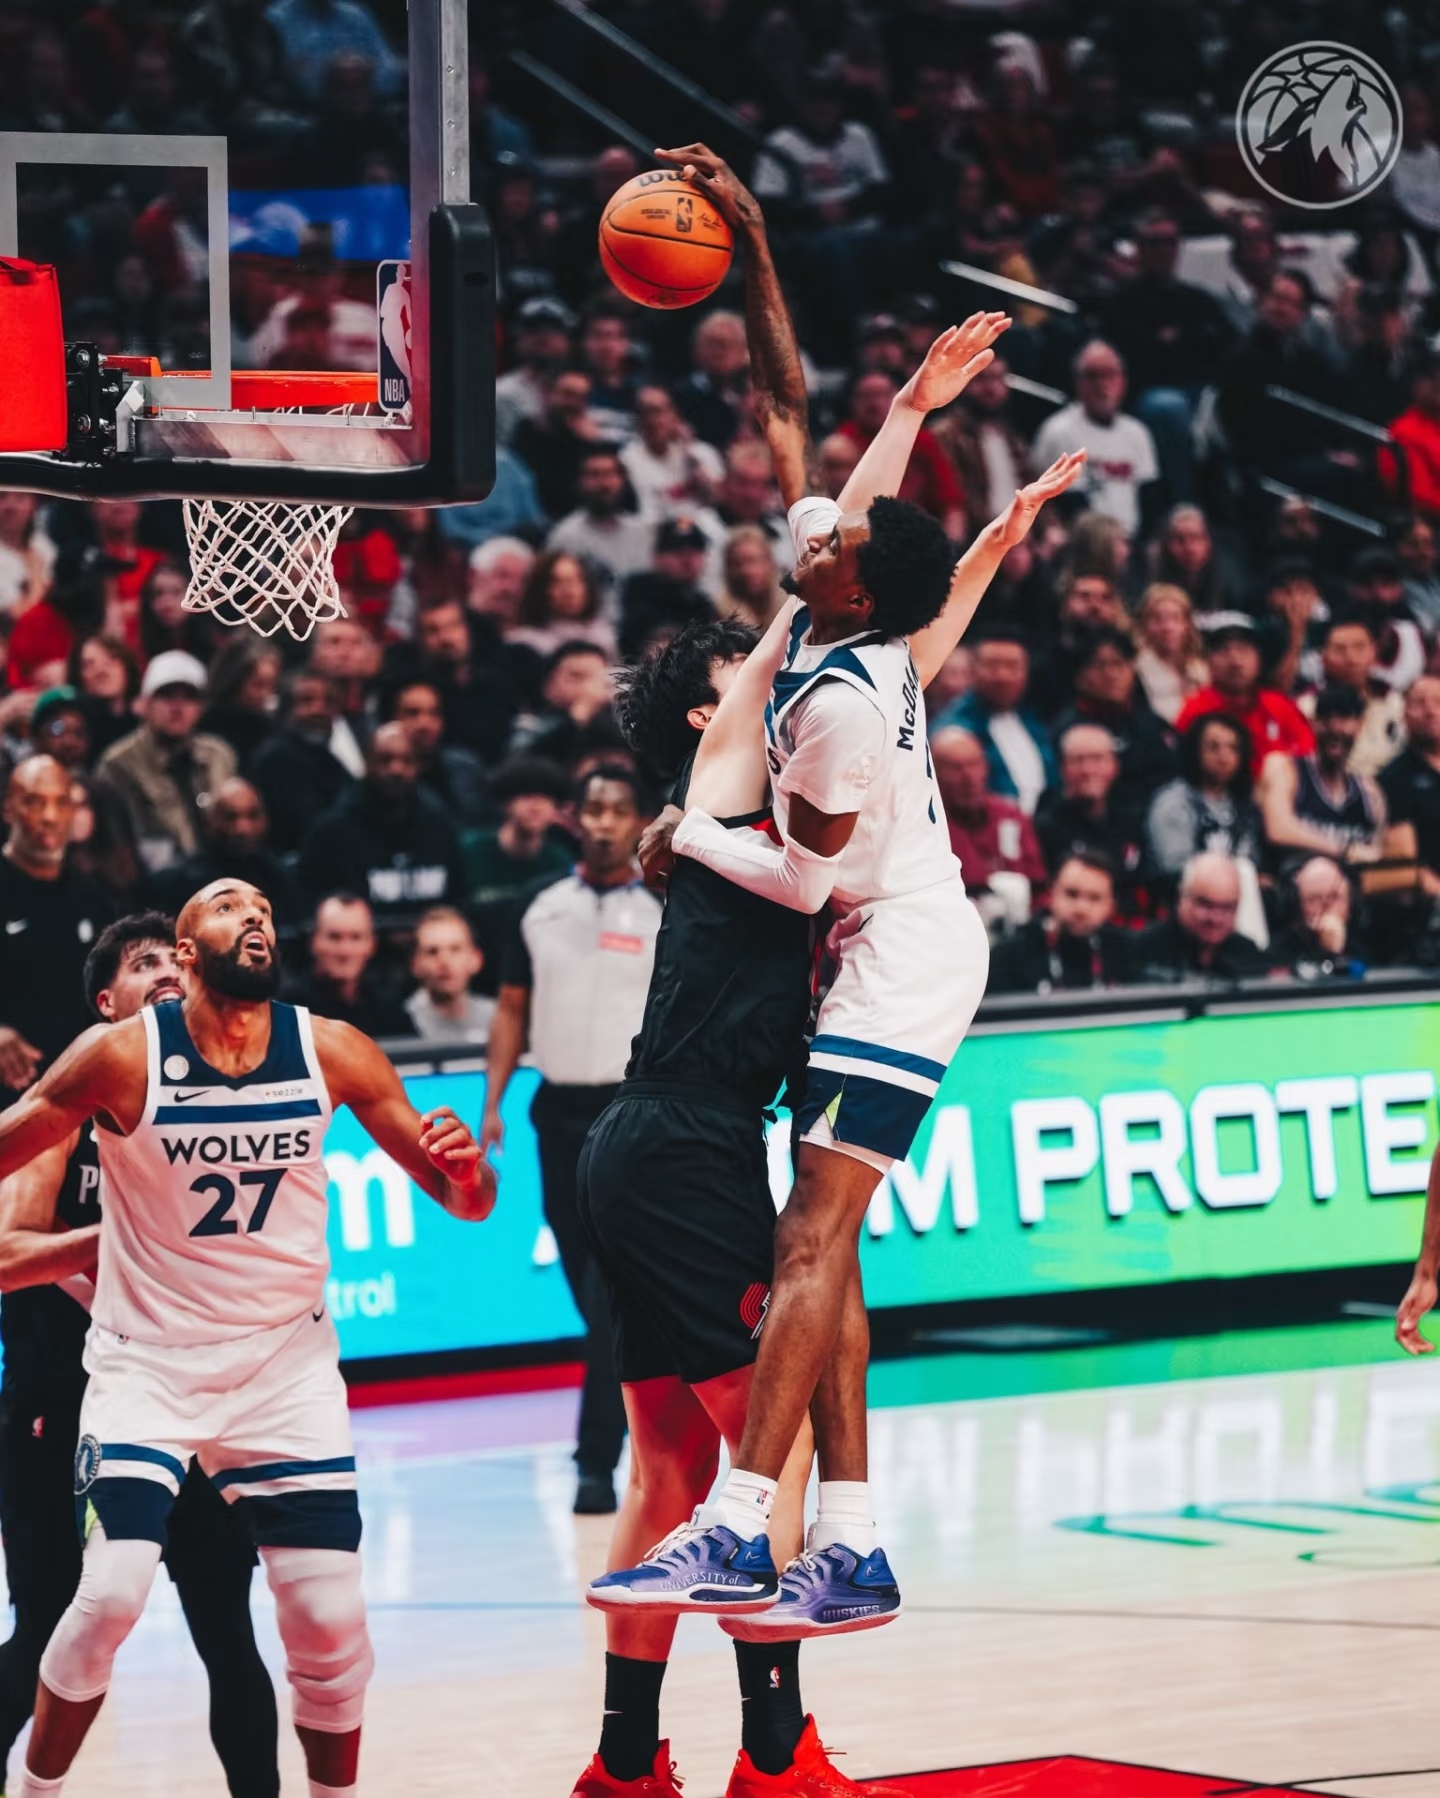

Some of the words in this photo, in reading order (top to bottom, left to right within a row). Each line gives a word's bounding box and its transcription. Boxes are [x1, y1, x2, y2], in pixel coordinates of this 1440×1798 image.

[384, 378, 406, 402] NBA
[767, 747, 782, 776] S
[160, 1130, 311, 1166] WOLVES
[78, 1164, 101, 1205] P
[323, 1148, 415, 1251] m
[188, 1168, 289, 1238] 27
[325, 1270, 397, 1320] trol
[660, 1570, 728, 1591] UNIVERSITY
[728, 1574, 740, 1585] of
[822, 1605, 881, 1620] HUSKIES
